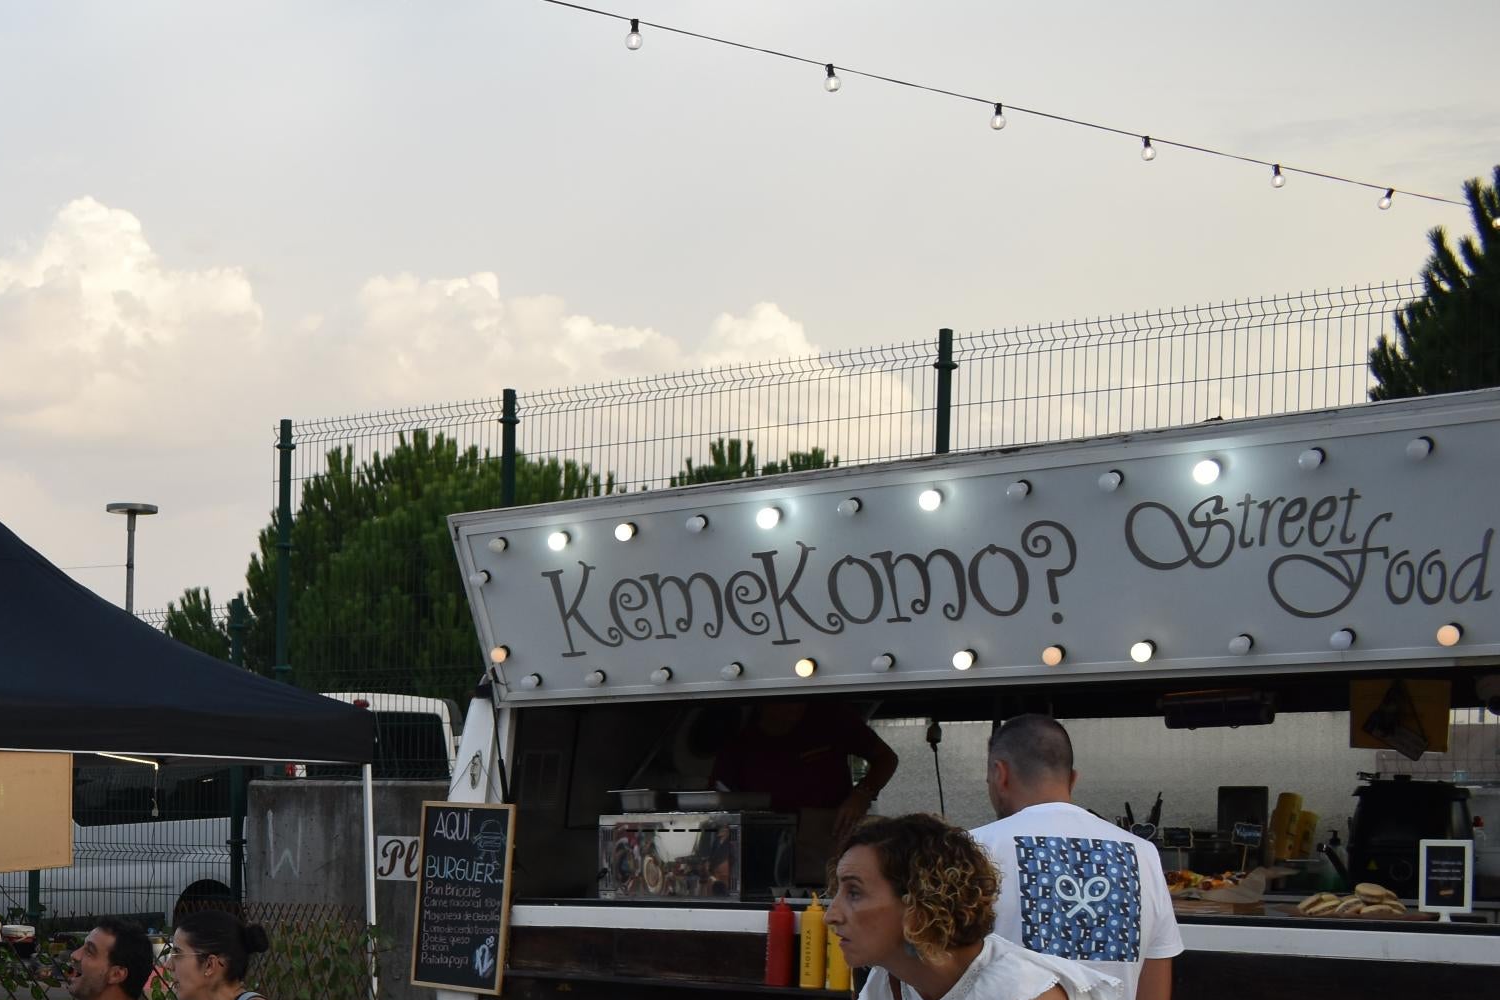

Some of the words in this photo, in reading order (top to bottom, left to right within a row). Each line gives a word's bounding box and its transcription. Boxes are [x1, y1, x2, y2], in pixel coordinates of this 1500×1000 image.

[1124, 487, 1363, 571] Street
[1268, 510, 1496, 619] Food
[433, 809, 474, 841] AQUÍ
